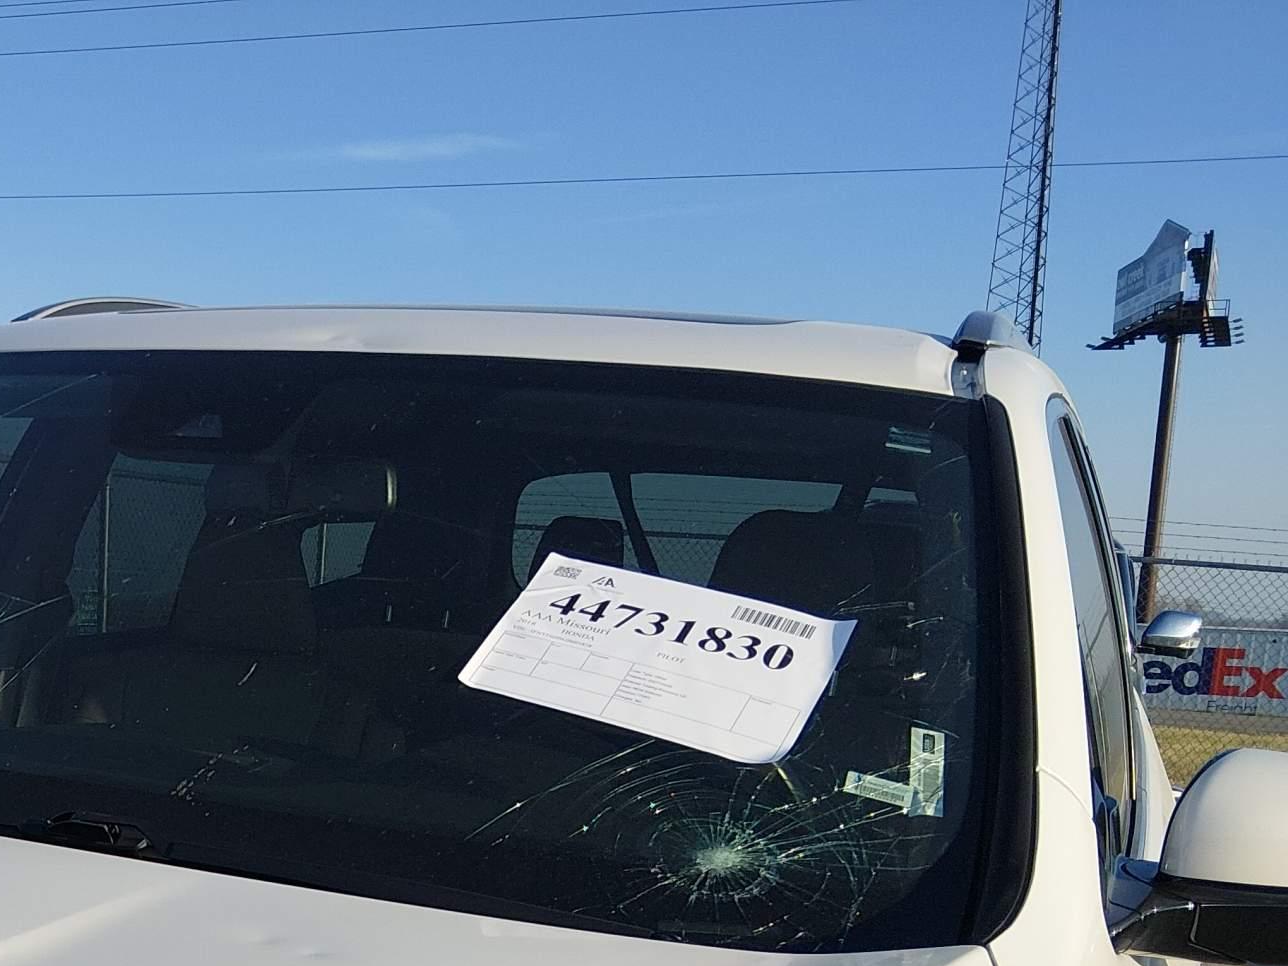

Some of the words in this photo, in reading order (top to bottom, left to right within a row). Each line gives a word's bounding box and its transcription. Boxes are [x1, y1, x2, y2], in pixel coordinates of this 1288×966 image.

[521, 609, 553, 623] AAA
[557, 616, 612, 636] Missouri
[549, 593, 795, 670] 44731830
[562, 629, 596, 642] HONDA
[656, 652, 686, 665] PILOT
[1143, 646, 1288, 699] edEx
